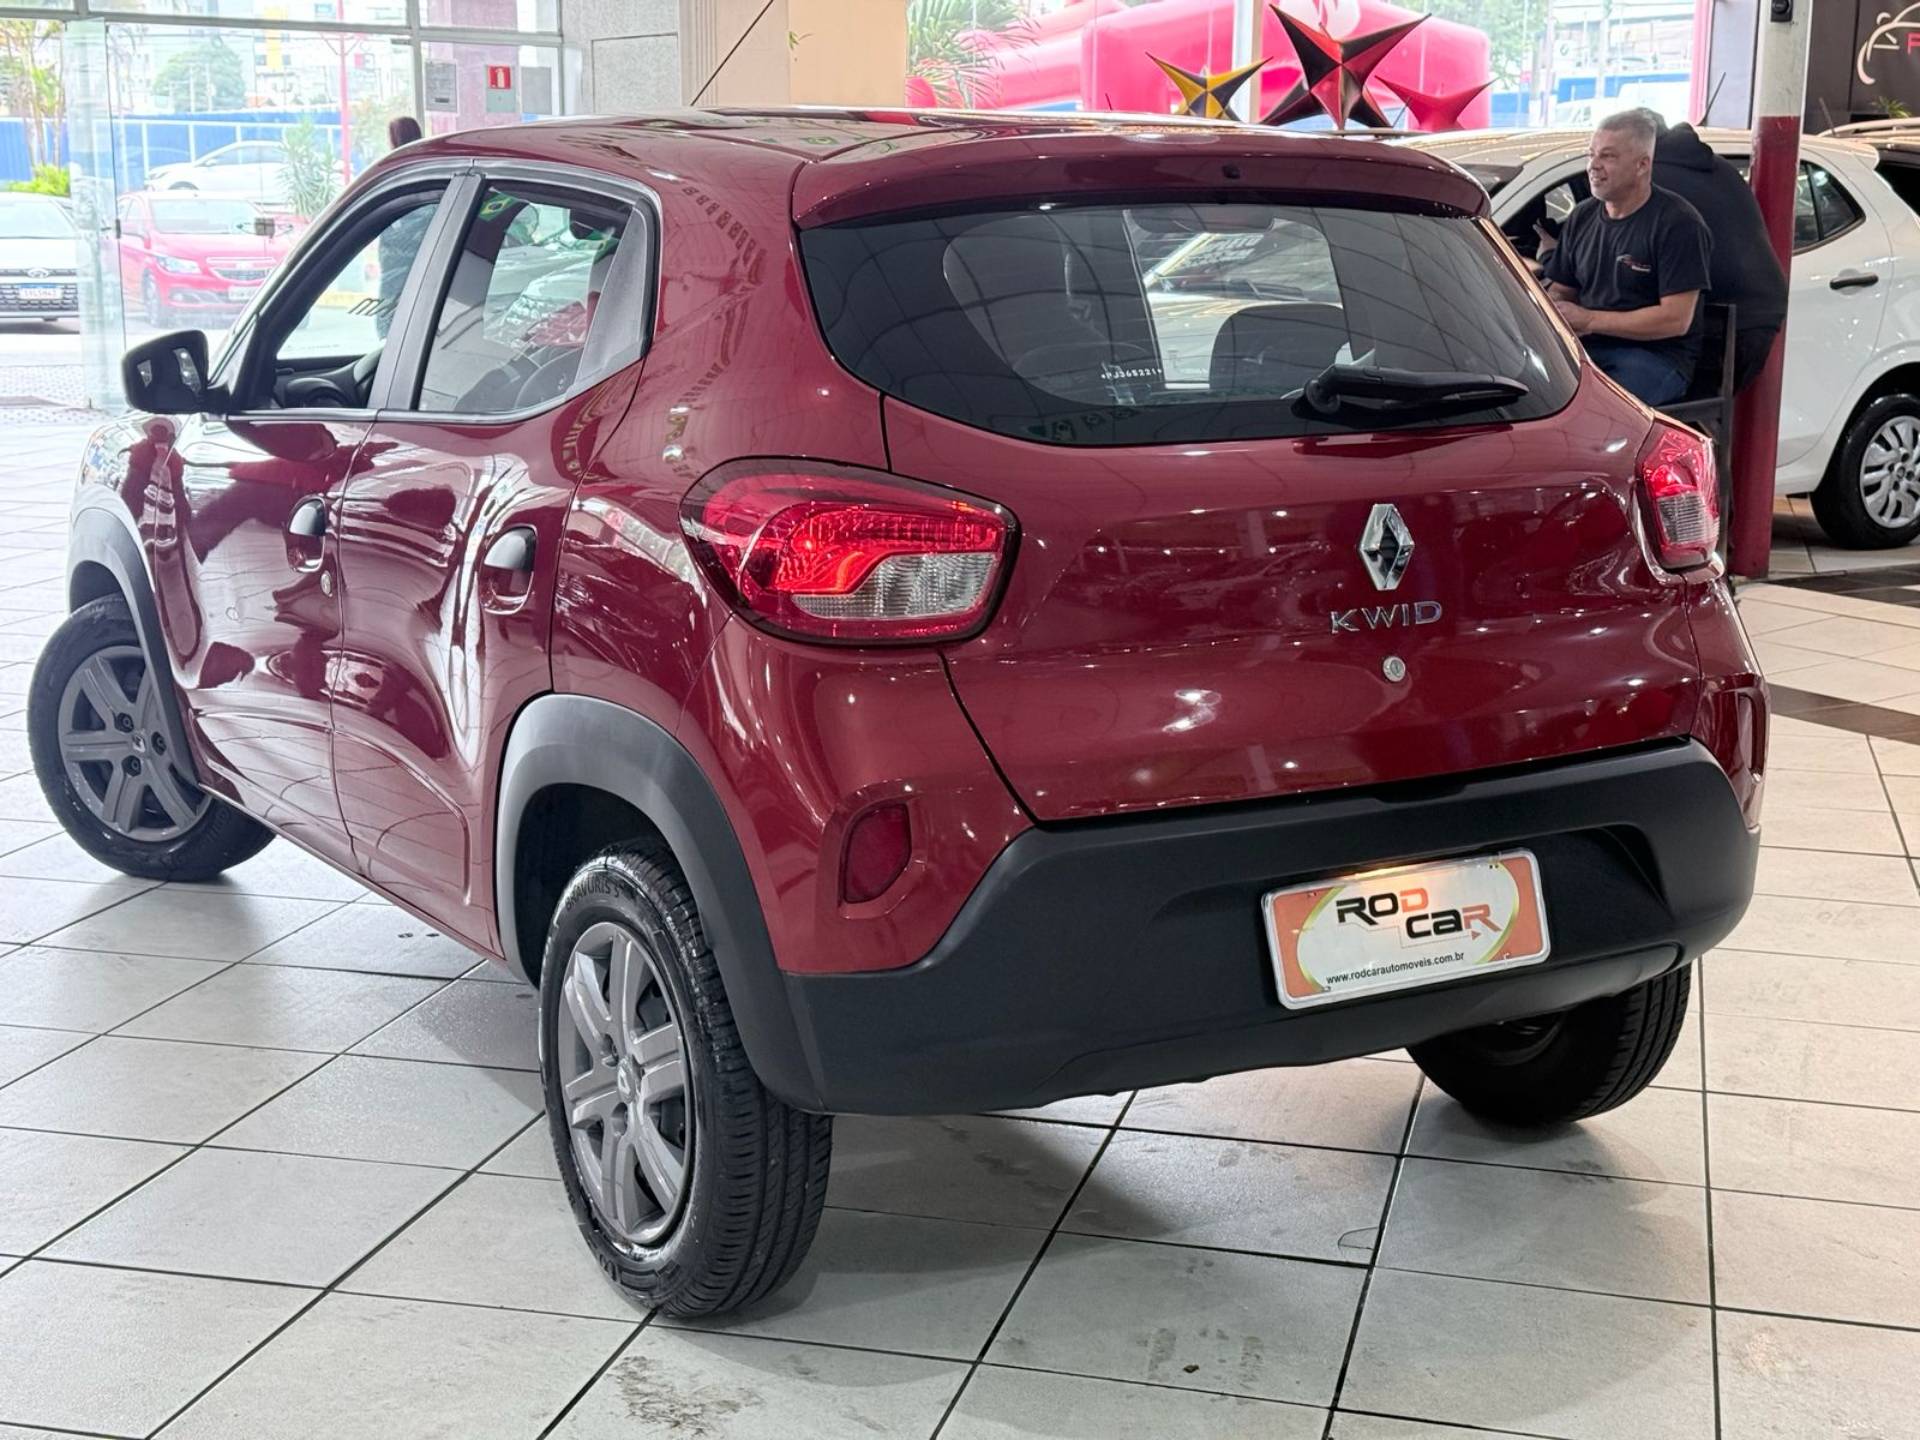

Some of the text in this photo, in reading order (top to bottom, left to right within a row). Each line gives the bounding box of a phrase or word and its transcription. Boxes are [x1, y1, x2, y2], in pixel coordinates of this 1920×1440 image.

[1330, 600, 1442, 634] KWID
[1336, 887, 1429, 926] ROD
[1326, 951, 1465, 985] www.rodcarautomoveis.com.br
